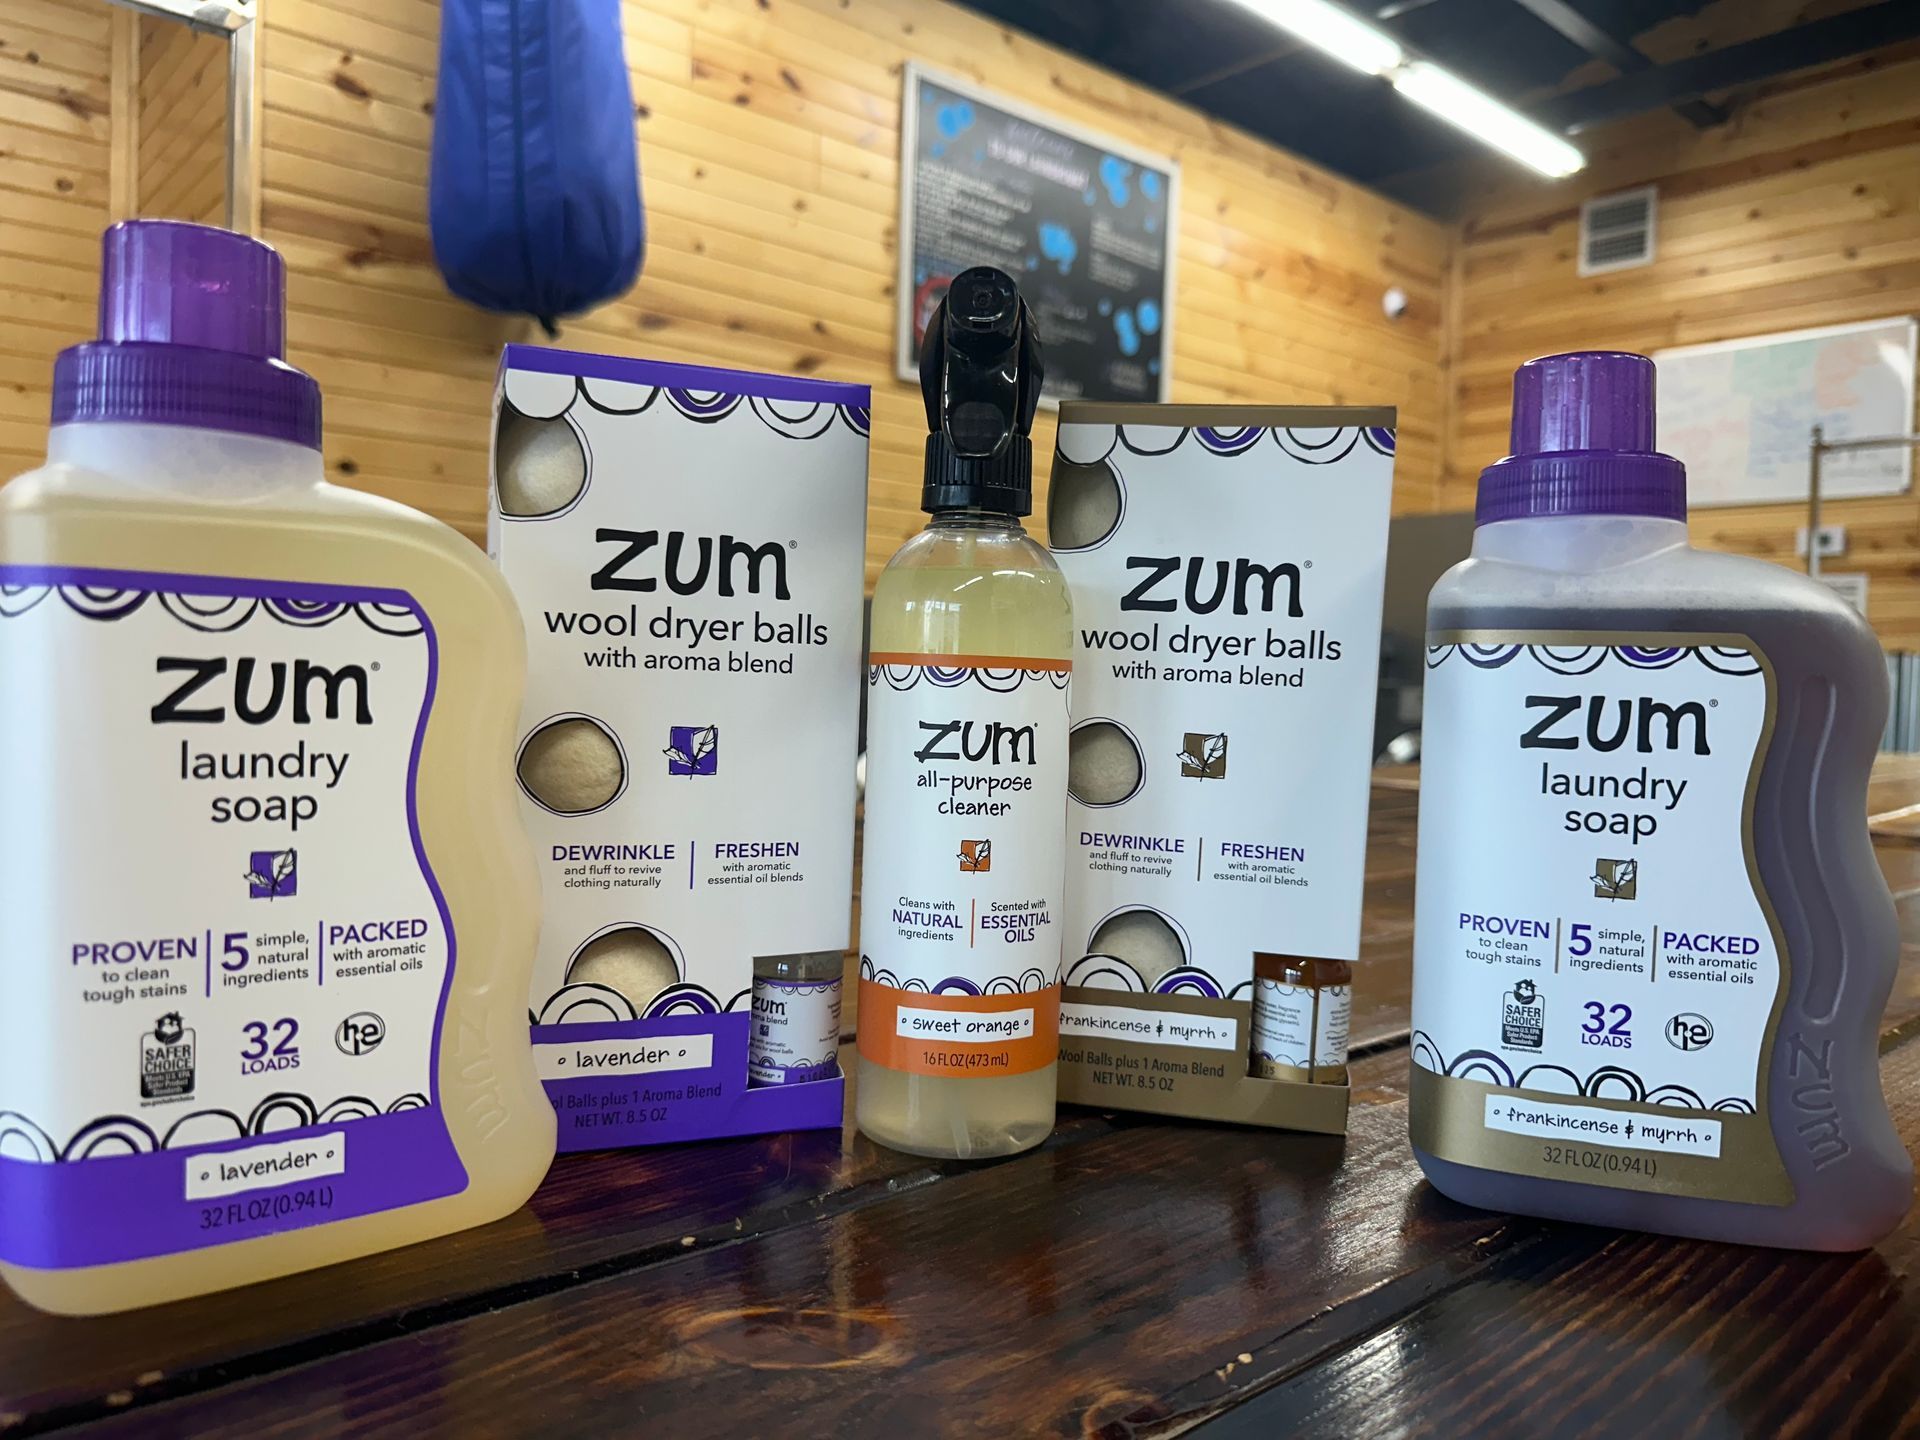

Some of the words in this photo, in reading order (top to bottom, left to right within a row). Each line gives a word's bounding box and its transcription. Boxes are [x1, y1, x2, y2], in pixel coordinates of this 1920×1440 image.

[545, 604, 636, 637] wool
[650, 606, 744, 648] dryer
[754, 611, 828, 646] balls
[1082, 623, 1158, 652] wool
[1169, 624, 1256, 663] dryer
[1265, 628, 1342, 660] balls
[584, 647, 636, 668] with
[644, 654, 720, 671] aroma
[728, 652, 793, 674] blend
[1112, 660, 1156, 680] with
[1163, 667, 1232, 683] aroma
[1239, 665, 1304, 687] blend
[181, 740, 349, 788] laundry
[917, 770, 1032, 797] all-purpose
[1541, 762, 1687, 810] laundry
[211, 794, 318, 831] soap
[938, 797, 1011, 816] cleaner
[1564, 810, 1657, 845] soap
[715, 842, 799, 859] FRESHEN
[1080, 832, 1185, 853] DEWRINKLE
[1221, 842, 1305, 862] FRESHEN
[552, 844, 675, 861] DEWRINKLE
[1089, 851, 1108, 860] and
[1110, 852, 1129, 861] fluff
[1131, 854, 1141, 862] to
[1144, 855, 1172, 865] revive
[564, 865, 586, 875] and
[589, 864, 611, 875] fluff
[614, 867, 626, 875] to
[628, 865, 662, 874] revive
[722, 862, 745, 872] with
[747, 861, 791, 871] aromatic
[1089, 862, 1127, 874] clothing
[1130, 866, 1172, 877] naturally
[1228, 861, 1249, 871] with
[1251, 864, 1295, 874] aromatic
[564, 877, 611, 889] clothing
[613, 877, 662, 889] naturally
[707, 875, 753, 885] essential
[755, 874, 768, 883] oil
[770, 872, 804, 883] blends
[1213, 872, 1256, 882] essential
[1259, 874, 1272, 884] oil
[1274, 876, 1309, 887] blends
[898, 896, 930, 910] Cleans
[933, 900, 955, 911] with
[991, 900, 1028, 912] Scented
[1030, 899, 1047, 910] with
[892, 909, 963, 929] NATURAL
[981, 911, 1051, 929] ESSENTIAL
[1460, 913, 1550, 939] PROVEN
[256, 930, 309, 948] simple,
[330, 919, 428, 945] PACKED
[898, 928, 954, 942] ingredients
[1004, 928, 1035, 943] OILS
[1568, 923, 1592, 956] 5
[1598, 929, 1646, 944] simple,
[72, 937, 197, 965] PROVEN
[221, 932, 249, 971] 5
[333, 948, 362, 962] with
[367, 943, 426, 959] aromatic
[1479, 936, 1492, 948] to
[1495, 937, 1528, 951] clean
[1599, 945, 1644, 957] natural
[1663, 931, 1760, 955] PACKED
[258, 948, 309, 965] natural
[1466, 949, 1501, 964] tough
[1505, 954, 1541, 967] stains
[1569, 957, 1644, 973] ingredients
[1666, 954, 1694, 966] with
[1698, 957, 1758, 970] aromatic
[102, 971, 119, 983] to
[125, 967, 169, 982] clean
[223, 967, 309, 988] ingredients
[336, 959, 396, 978] essential
[400, 958, 423, 972] oils
[1668, 969, 1727, 982] essential
[1730, 972, 1754, 985] oils
[83, 986, 135, 1004] tough
[140, 984, 187, 998] stains
[766, 1016, 788, 1025] blend
[1506, 1004, 1541, 1018] SAFER
[1581, 1001, 1632, 1036] 32
[913, 1018, 960, 1033] sweet
[966, 1022, 1020, 1036] orange
[1059, 1012, 1150, 1033] frankincense
[1170, 1025, 1216, 1041] myrrh
[1505, 1015, 1541, 1027] CHOICE
[241, 1017, 299, 1060] 32
[1582, 1033, 1632, 1049] LOADS
[145, 1044, 191, 1061] SAFER
[576, 1047, 669, 1068] lavender
[923, 1051, 936, 1065] 16
[938, 1054, 949, 1066] FL
[145, 1058, 192, 1073] CHOICE
[242, 1055, 300, 1075] LOADS
[1087, 1052, 1112, 1067] Balls
[1116, 1055, 1139, 1070] plus
[1143, 1057, 1148, 1069] 1
[1151, 1060, 1188, 1074] Aroma
[1192, 1061, 1225, 1077] Blend
[1093, 1071, 1115, 1085] NET
[1137, 1076, 1155, 1090] 8.5
[1159, 1078, 1174, 1091] OZ
[568, 1094, 597, 1110] Balls
[601, 1091, 628, 1108] plus
[633, 1089, 638, 1102] 1
[642, 1088, 682, 1103] Aroma
[687, 1083, 722, 1100] Blend
[574, 1114, 598, 1129] NET
[627, 1110, 647, 1124] 8.5
[651, 1108, 667, 1122] OZ
[1507, 1107, 1618, 1134] frankincense
[1641, 1126, 1697, 1144] myrrh
[1543, 1147, 1560, 1164] 32
[1566, 1150, 1579, 1166] FL
[220, 1152, 317, 1181] lavender
[201, 1207, 223, 1229] 32
[228, 1203, 246, 1224] FL
